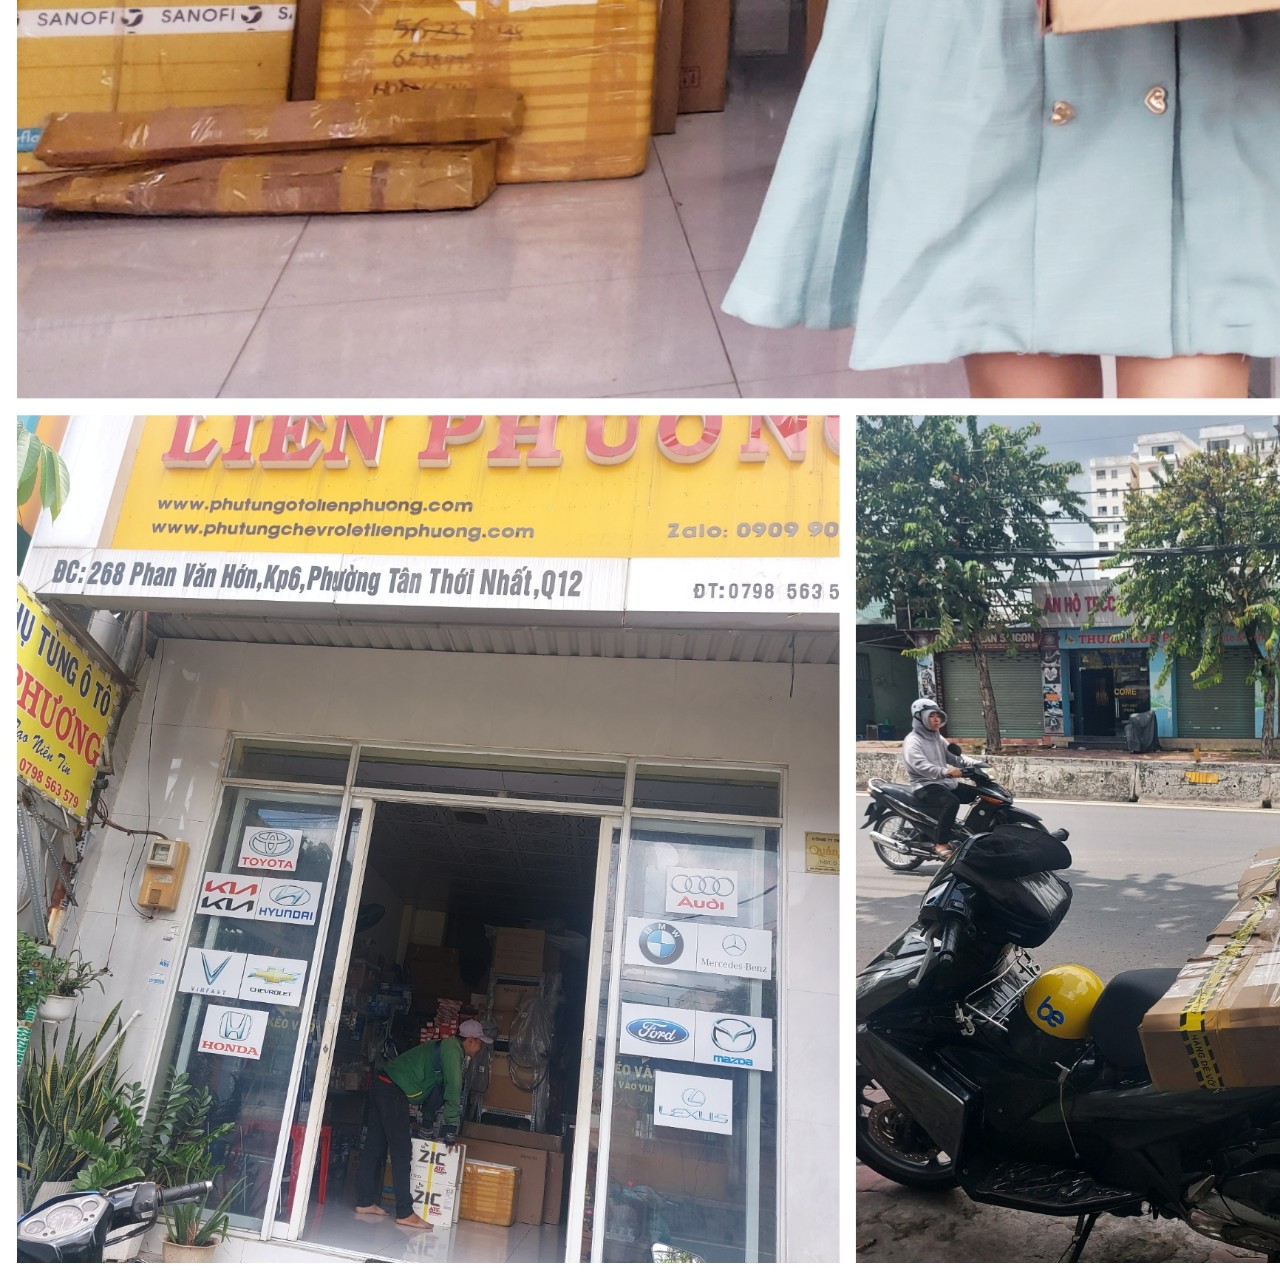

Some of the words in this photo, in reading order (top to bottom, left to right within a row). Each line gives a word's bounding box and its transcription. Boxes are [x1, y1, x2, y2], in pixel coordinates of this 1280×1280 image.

[37, 10, 115, 28] SANOFI
[160, 7, 235, 24] SANOFI
[666, 521, 729, 540] Zalo:
[735, 520, 799, 540] 0909
[807, 521, 839, 539] 90
[86, 560, 124, 586] 268
[128, 561, 176, 588] Phan
[182, 560, 217, 589] Văn
[388, 565, 422, 595] Tân
[429, 566, 475, 596] Thới
[786, 582, 823, 601] 563
[37, 622, 79, 689] TÙNG
[92, 679, 112, 717] TÔ
[1113, 687, 1137, 696] COME
[18, 757, 43, 784] 0798
[44, 776, 62, 799] 563
[62, 786, 80, 810] 579
[241, 855, 294, 870] TOYOTA
[676, 895, 725, 911] Audi
[258, 906, 314, 922] HYUNDAI
[643, 921, 681, 939] BMW
[249, 986, 292, 998] CHEVROLET
[1036, 995, 1065, 1028] be
[201, 1039, 259, 1058] HONDA
[637, 1020, 676, 1043] Ford
[712, 1053, 754, 1068] mazda
[657, 1104, 729, 1125] LEXUS
[418, 1148, 447, 1167] ZIC
[413, 1188, 442, 1207] ZIC
